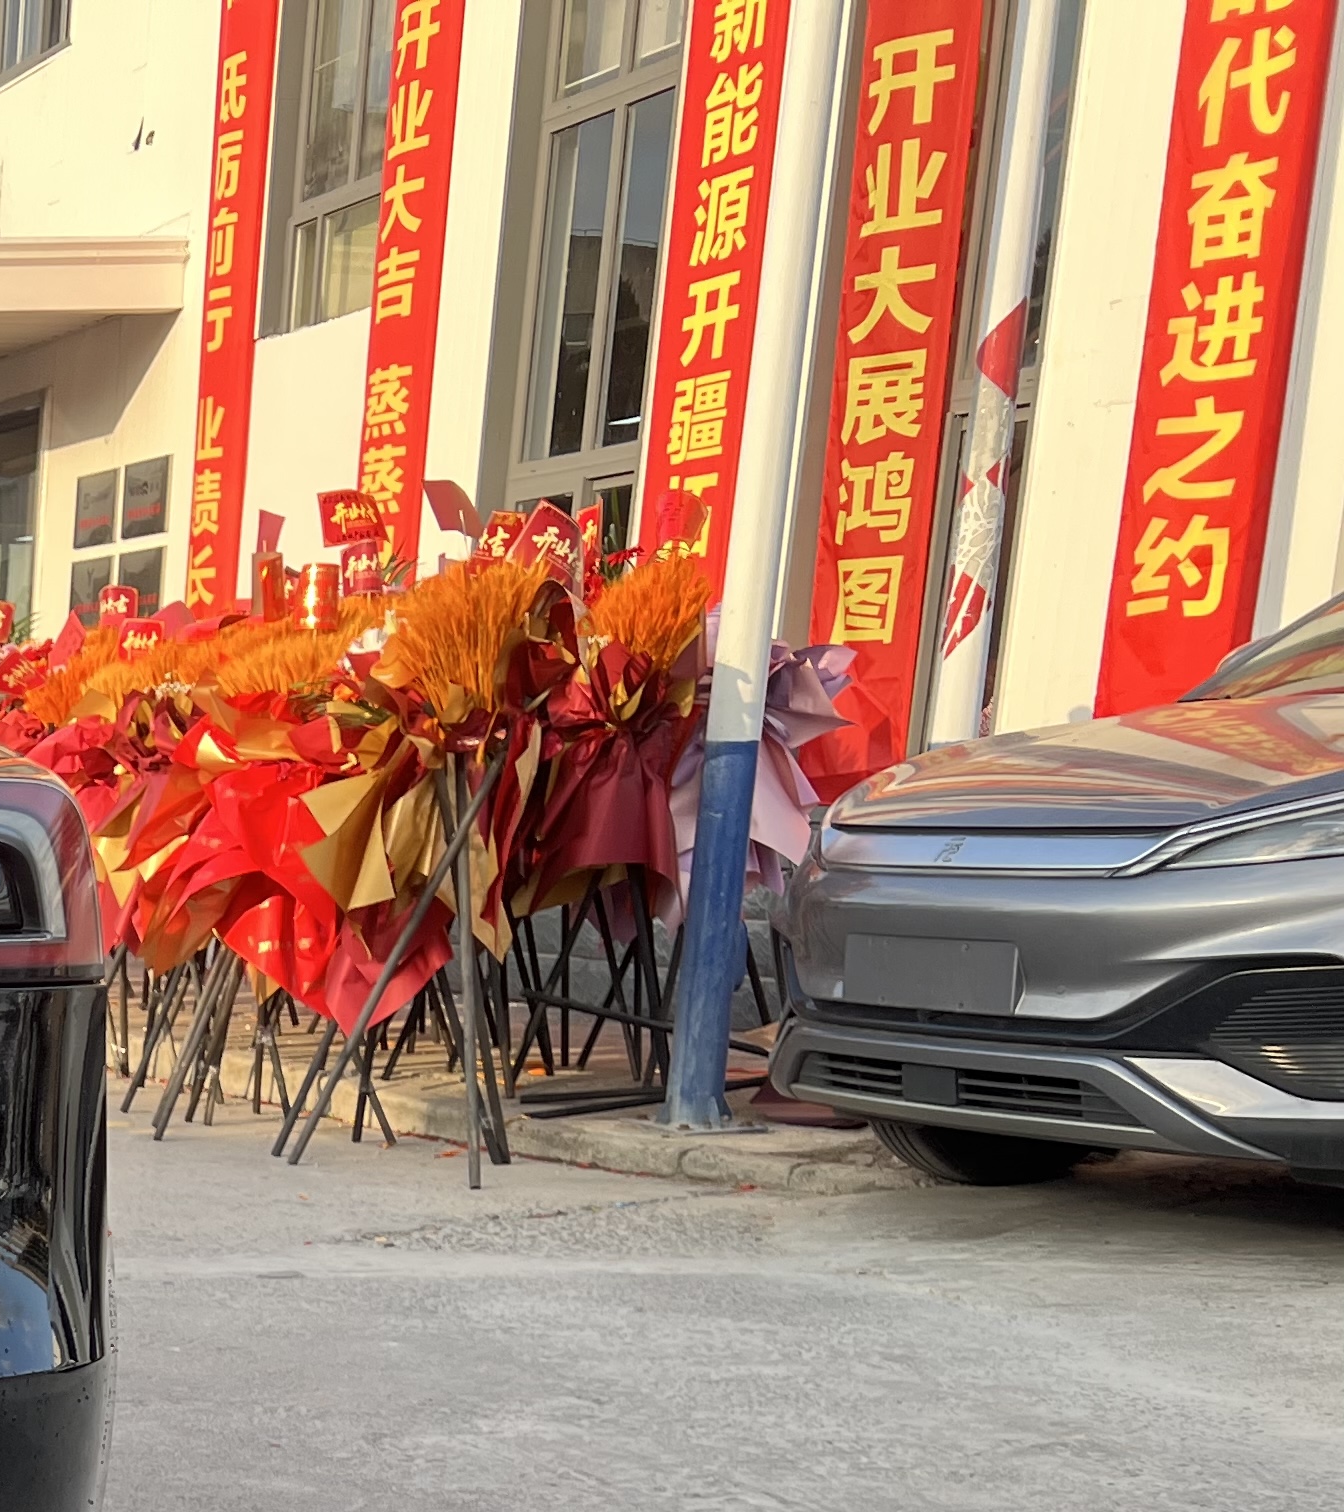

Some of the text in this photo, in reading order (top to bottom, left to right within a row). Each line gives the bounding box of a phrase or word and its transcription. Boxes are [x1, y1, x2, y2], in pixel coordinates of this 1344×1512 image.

[375, 0, 441, 325] 开业大吉
[829, 28, 956, 645] 开业大展鸿图
[1125, 0, 1296, 618] 代奋进之约
